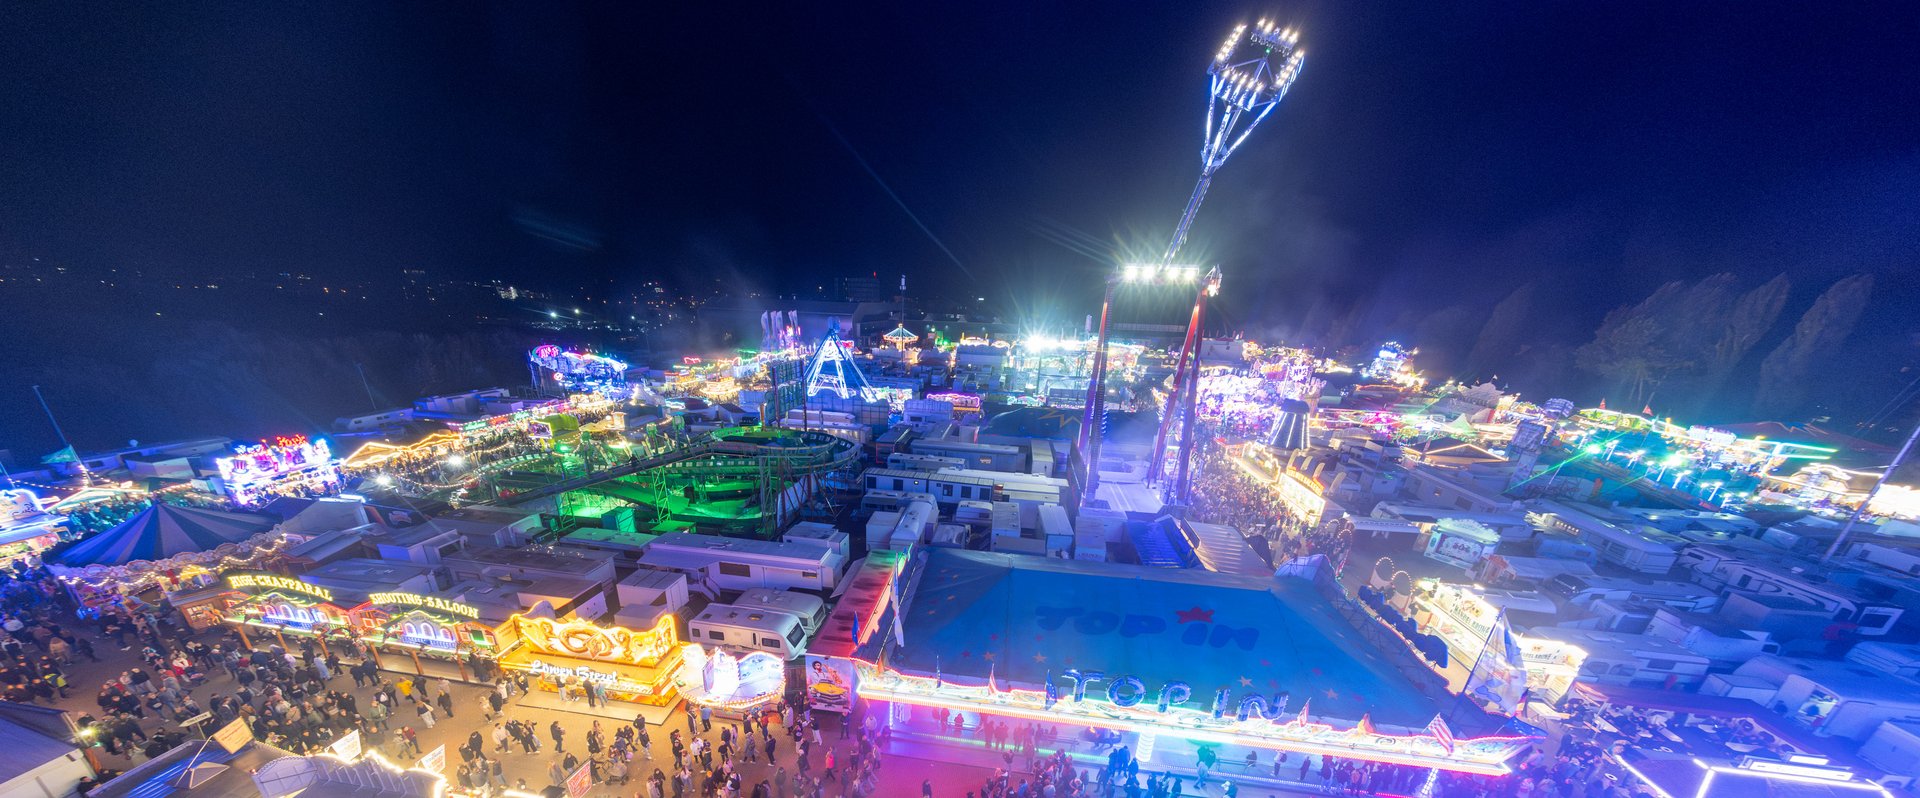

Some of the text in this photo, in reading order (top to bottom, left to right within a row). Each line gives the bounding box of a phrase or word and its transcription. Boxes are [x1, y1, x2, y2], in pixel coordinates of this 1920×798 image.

[227, 574, 333, 602] HIGH-CHAPPARAL
[369, 592, 479, 619] SHOOTING-SALOON
[1061, 668, 1289, 722] TOP IN
